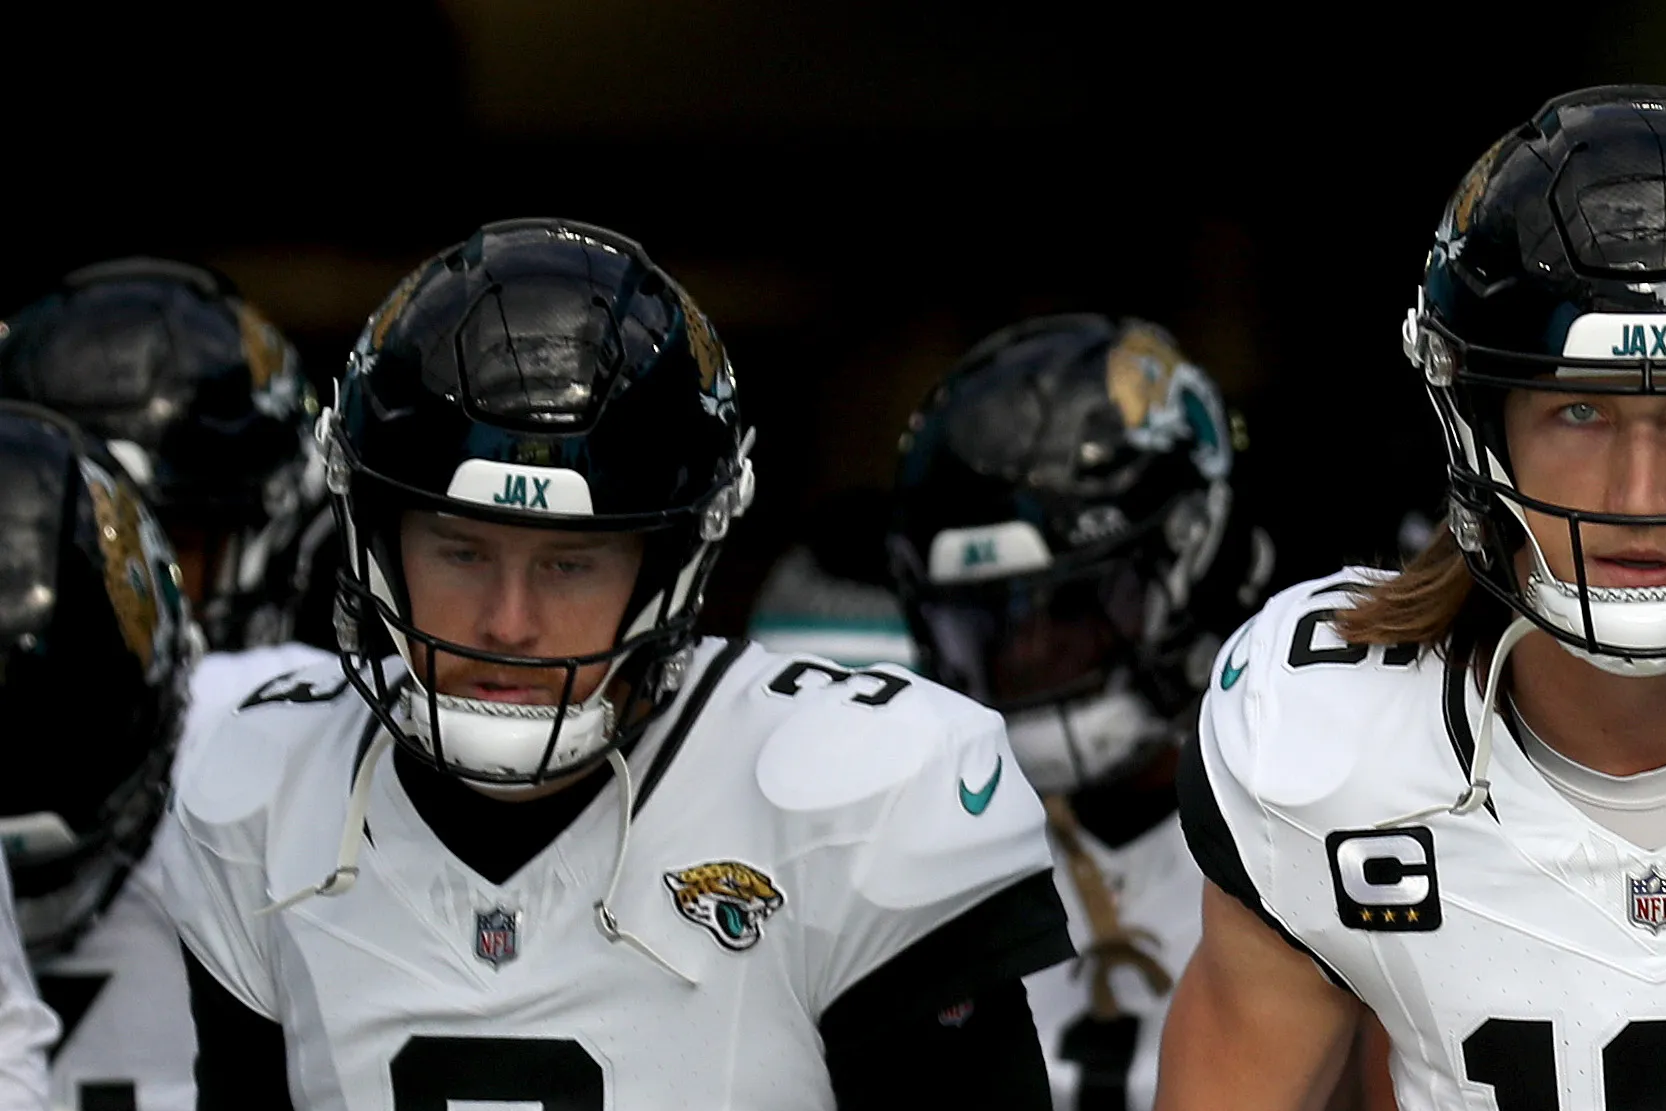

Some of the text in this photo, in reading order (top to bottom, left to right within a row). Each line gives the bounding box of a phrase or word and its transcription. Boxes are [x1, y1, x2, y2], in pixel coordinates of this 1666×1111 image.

[493, 473, 551, 509] JAX
[1337, 834, 1430, 906] C
[480, 930, 514, 957] NFL
